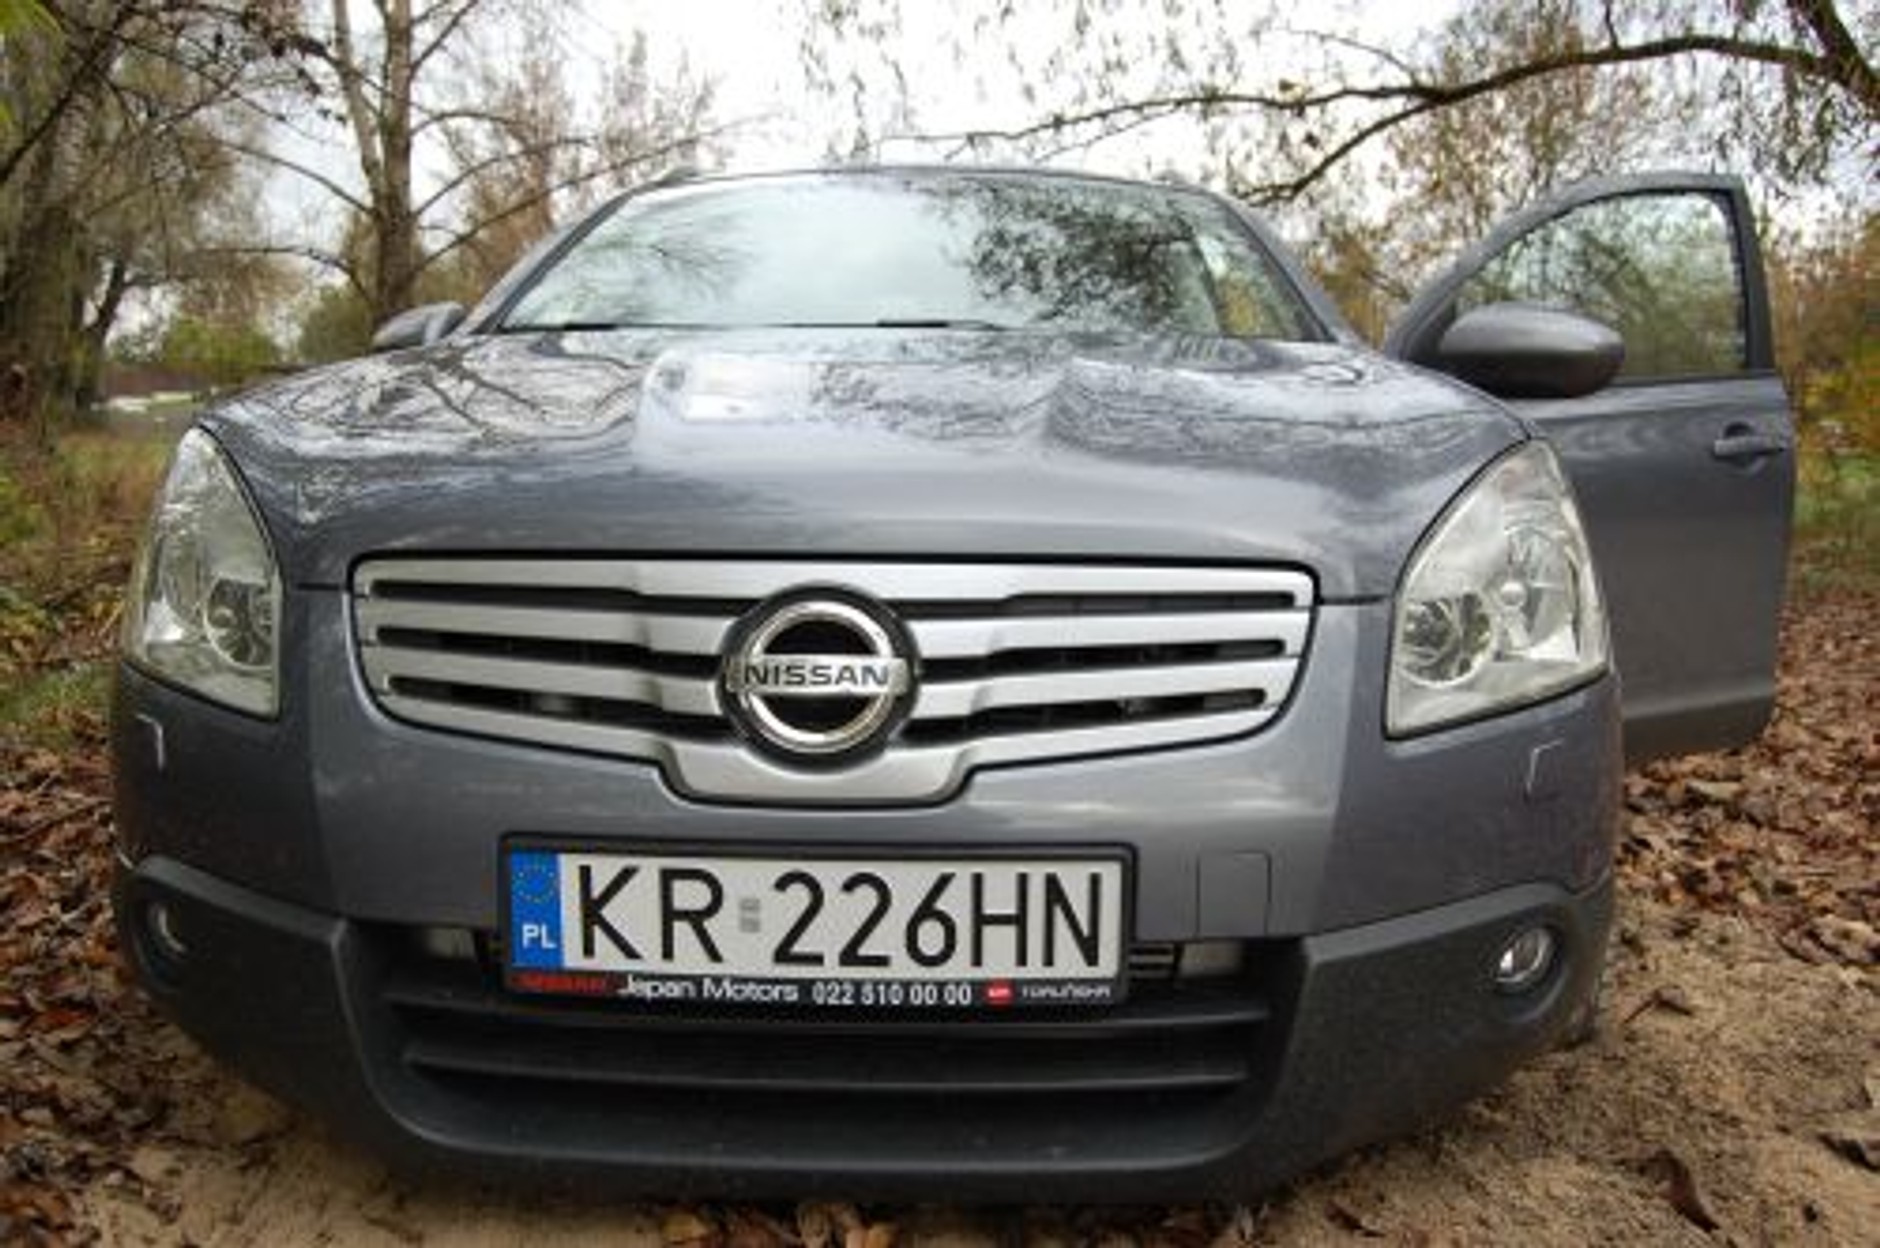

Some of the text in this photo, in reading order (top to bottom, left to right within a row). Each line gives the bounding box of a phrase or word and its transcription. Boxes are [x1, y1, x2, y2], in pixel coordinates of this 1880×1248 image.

[745, 664, 888, 686] NISSAN
[577, 865, 1102, 967] KR 226HN
[522, 923, 557, 949] PL
[616, 973, 697, 1001] Japan
[701, 977, 799, 1001] Motors
[811, 980, 855, 1005] 022
[909, 983, 938, 1006] 00
[943, 983, 972, 1006] 00
